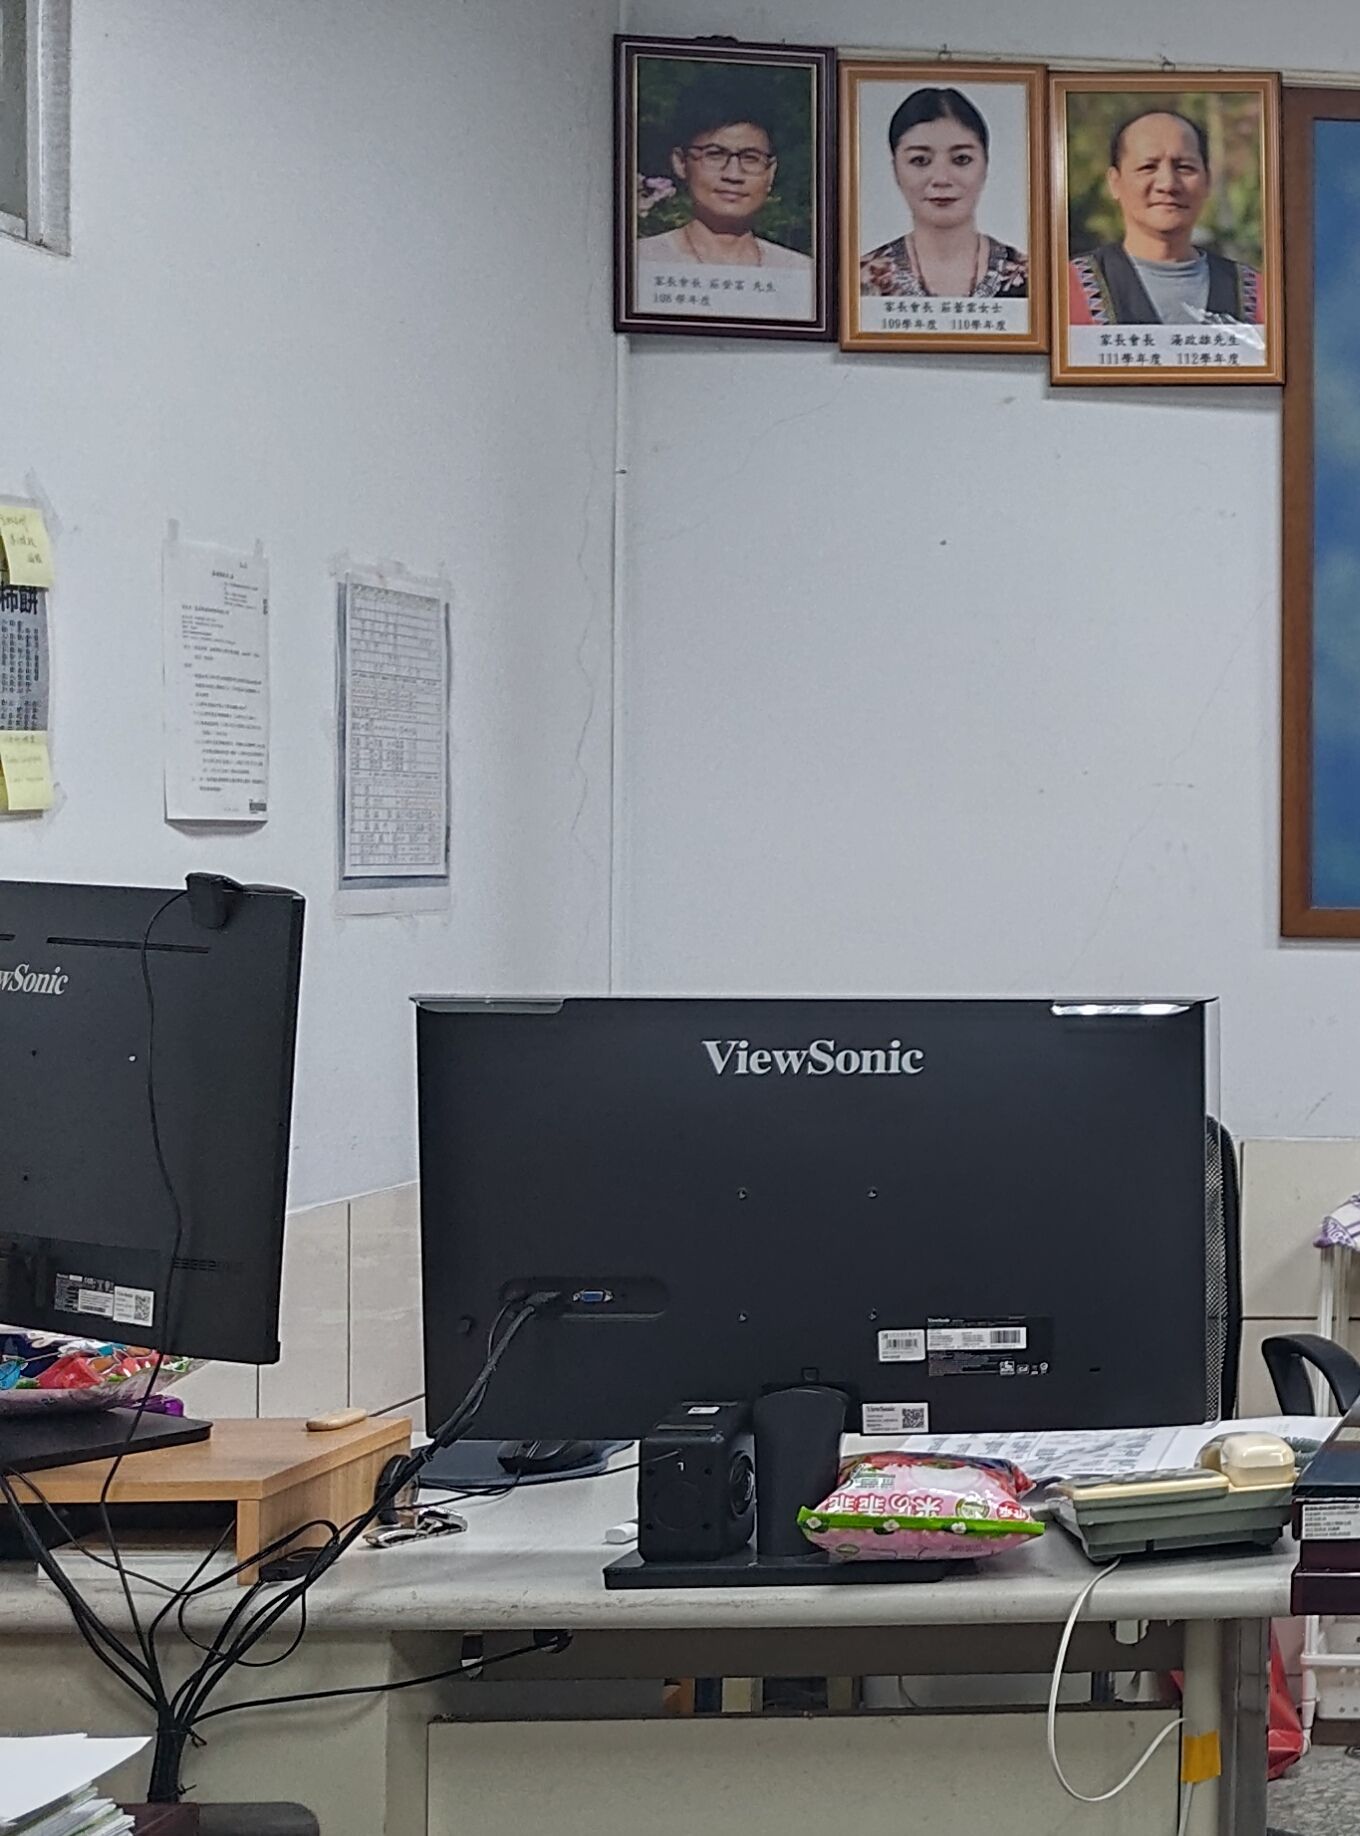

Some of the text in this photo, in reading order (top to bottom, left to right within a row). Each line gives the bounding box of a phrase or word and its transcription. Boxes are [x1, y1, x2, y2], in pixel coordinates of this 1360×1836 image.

[885, 301, 934, 313] 家長會長
[882, 318, 1007, 331] 109學年度 110學年度
[1100, 333, 1156, 346] 家長會長
[1100, 353, 1240, 366] 111學年度 112學年度
[701, 1039, 925, 1075] ViewSonic
